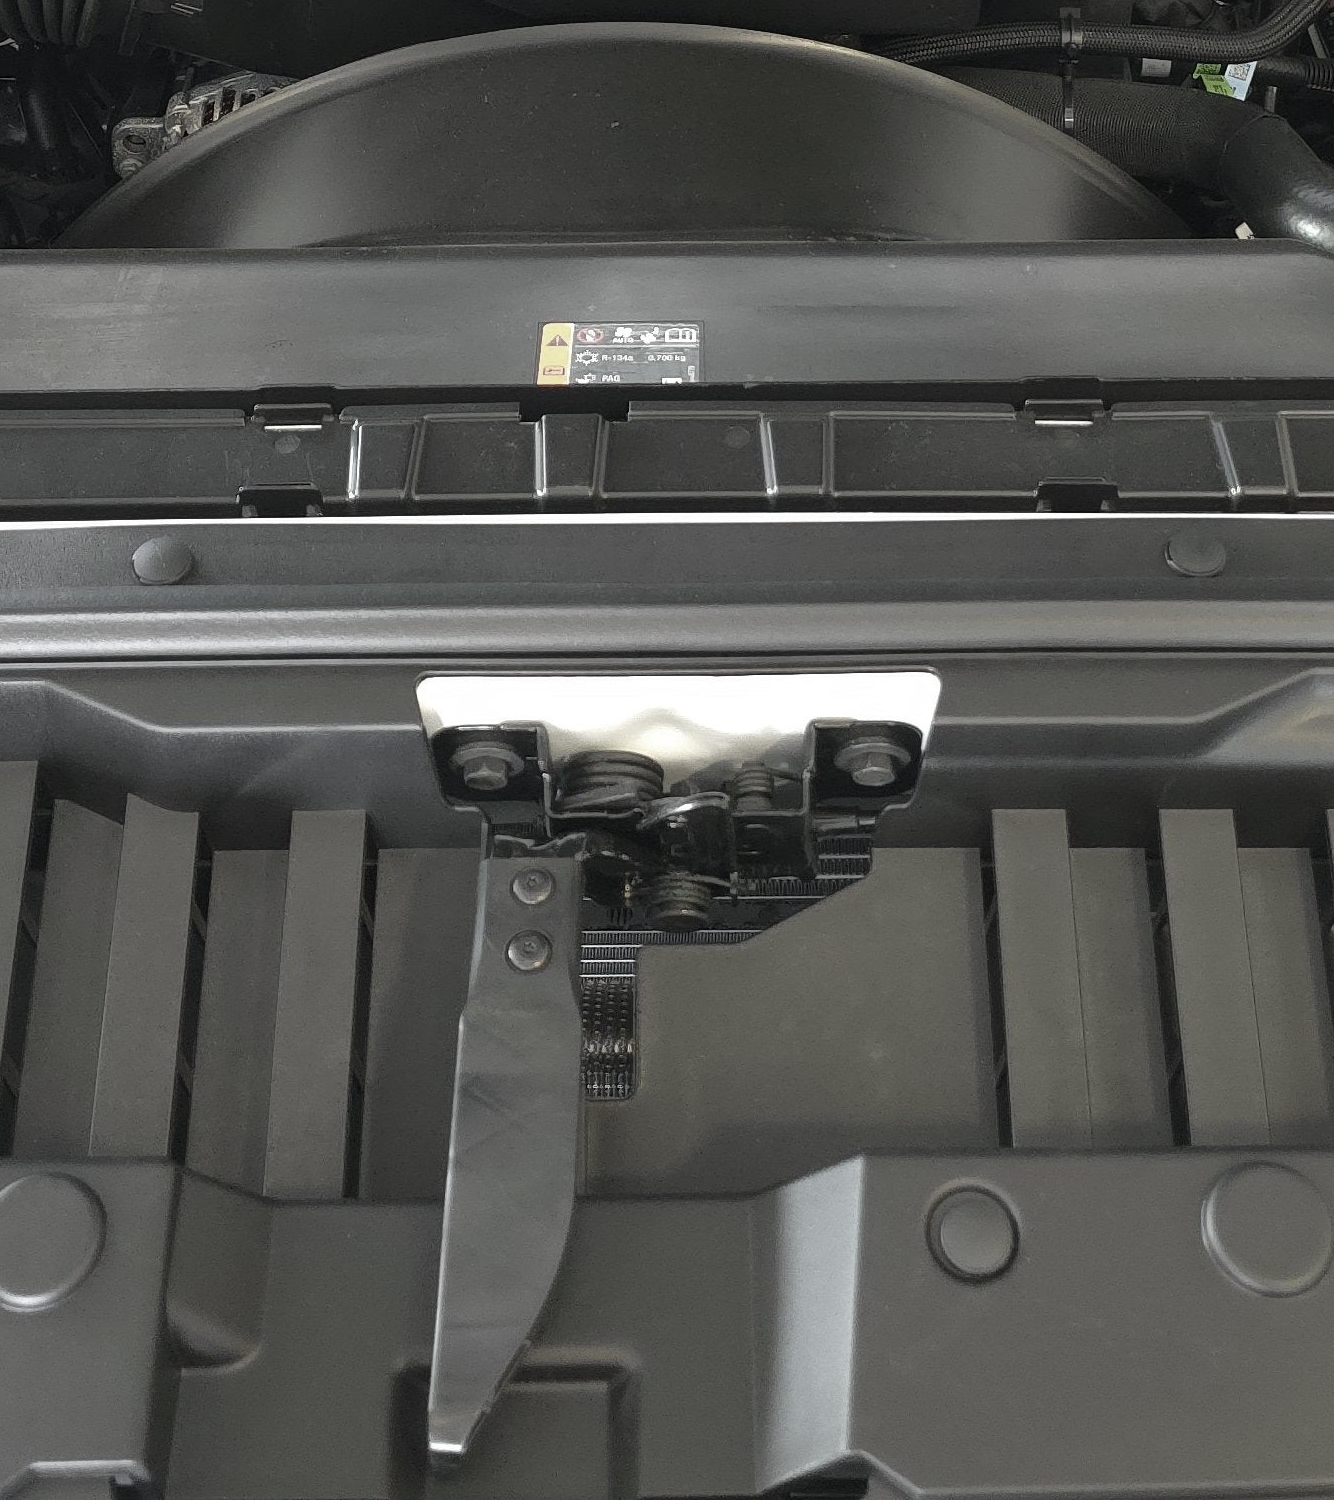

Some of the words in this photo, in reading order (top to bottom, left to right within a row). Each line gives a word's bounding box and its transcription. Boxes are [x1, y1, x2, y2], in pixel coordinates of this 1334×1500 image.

[601, 354, 634, 362] R-134a
[675, 354, 686, 362] kg
[601, 374, 621, 382] PAG
